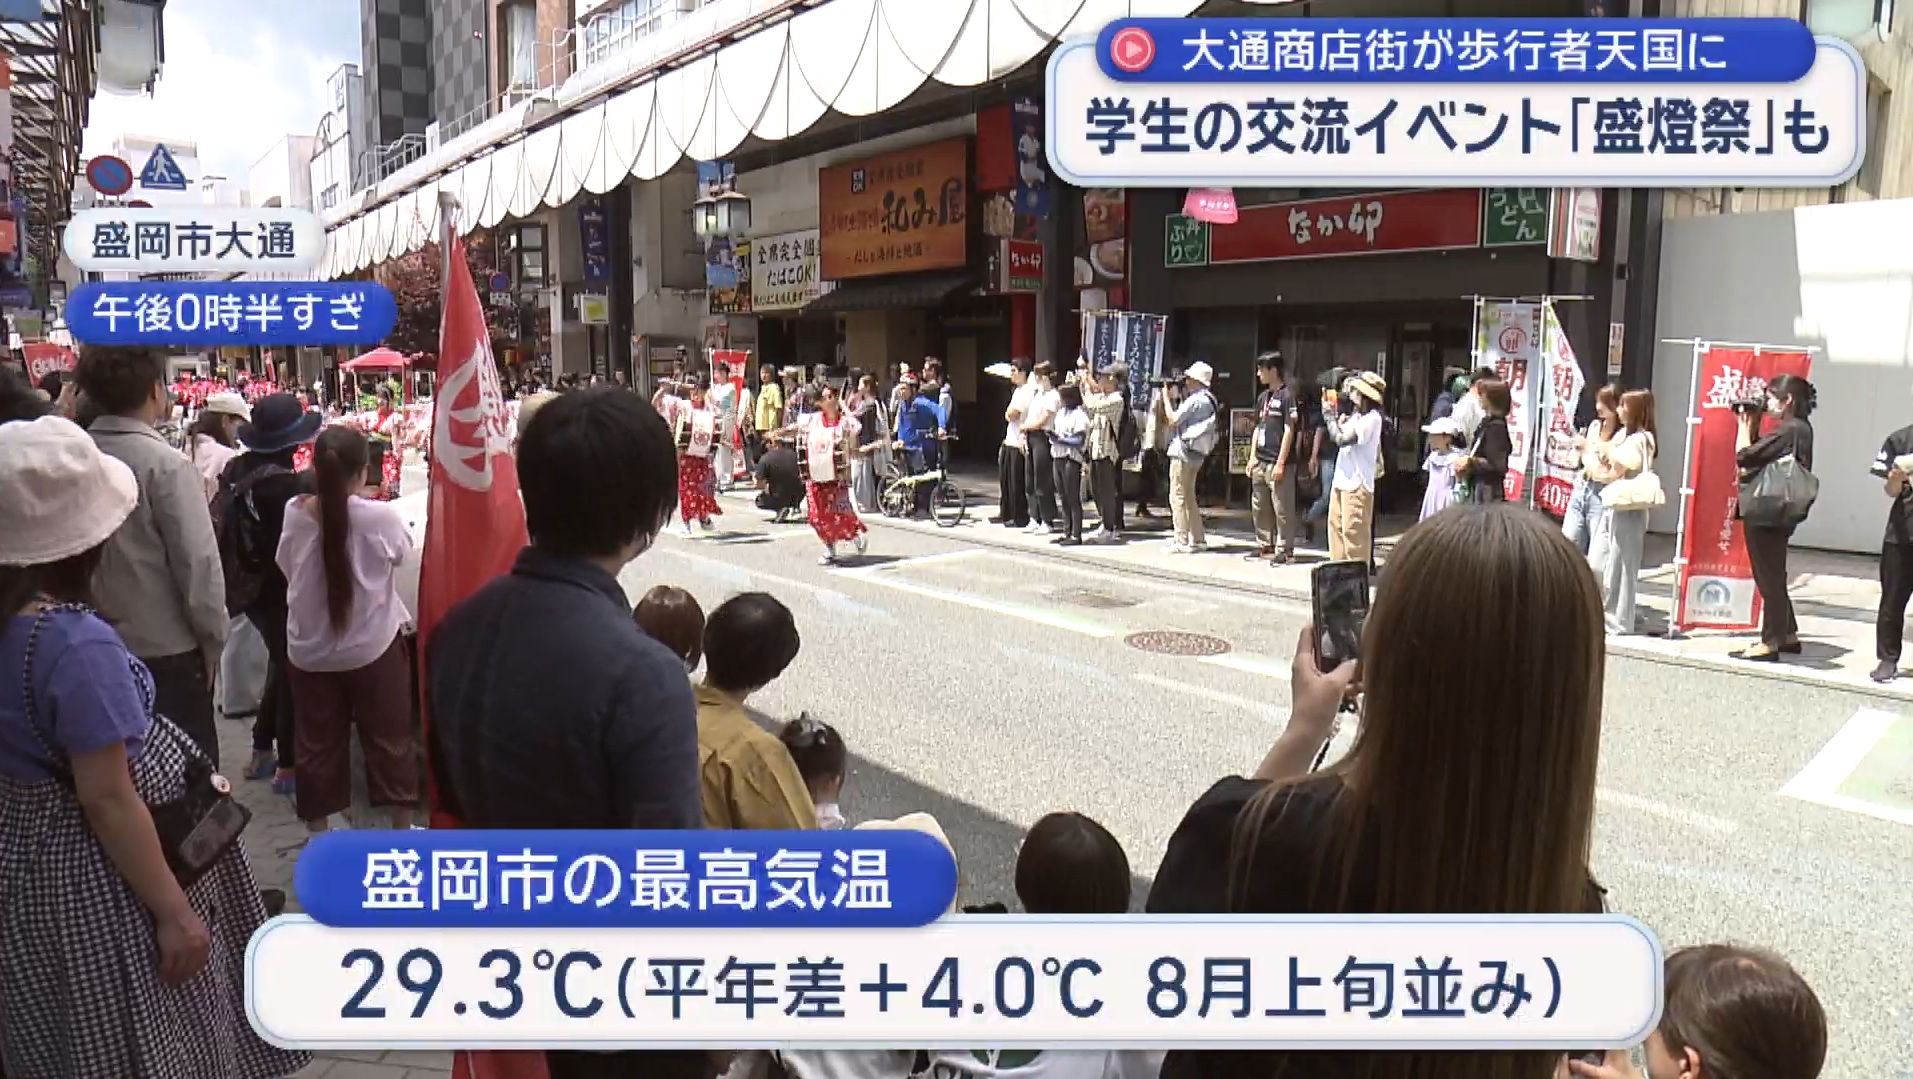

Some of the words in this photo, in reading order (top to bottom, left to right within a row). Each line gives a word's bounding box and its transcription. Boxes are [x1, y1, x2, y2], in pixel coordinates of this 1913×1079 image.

[880, 176, 965, 235] 和み屋
[1288, 201, 1383, 246] なか卯
